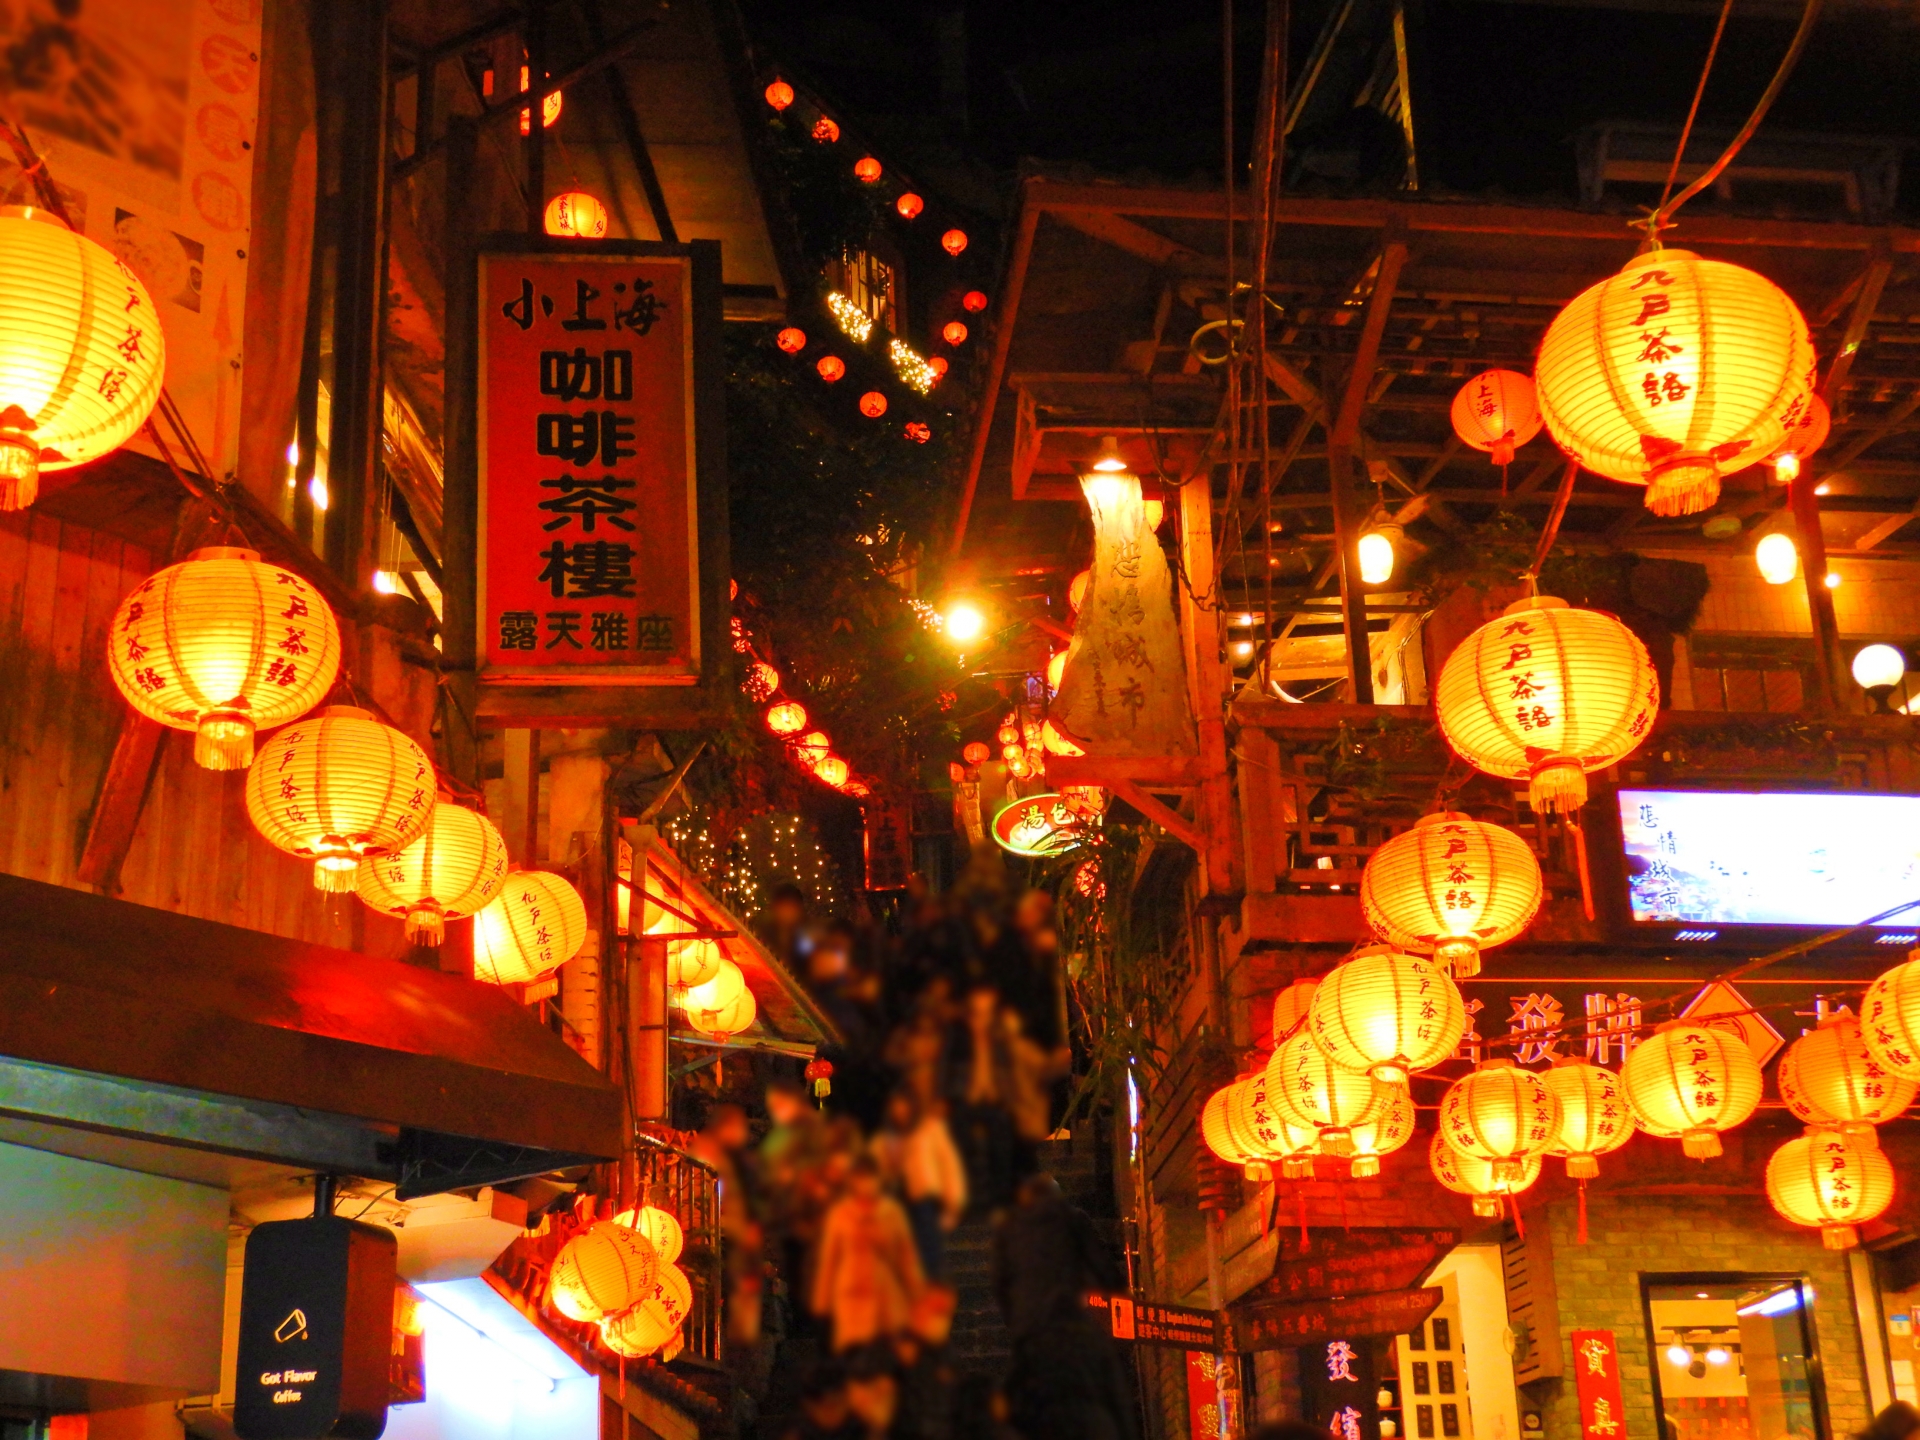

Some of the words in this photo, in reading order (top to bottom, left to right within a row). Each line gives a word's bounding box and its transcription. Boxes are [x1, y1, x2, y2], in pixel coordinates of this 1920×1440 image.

[502, 277, 667, 336] 小上海
[537, 347, 637, 599] 咖啡茶樓
[499, 611, 676, 652] 露天雅座
[1020, 803, 1072, 829] 湯包
[1638, 804, 1679, 911] 悲情城市
[260, 1372, 282, 1385] Got
[283, 1369, 318, 1383] Flavor
[273, 1389, 302, 1404] Coffee
